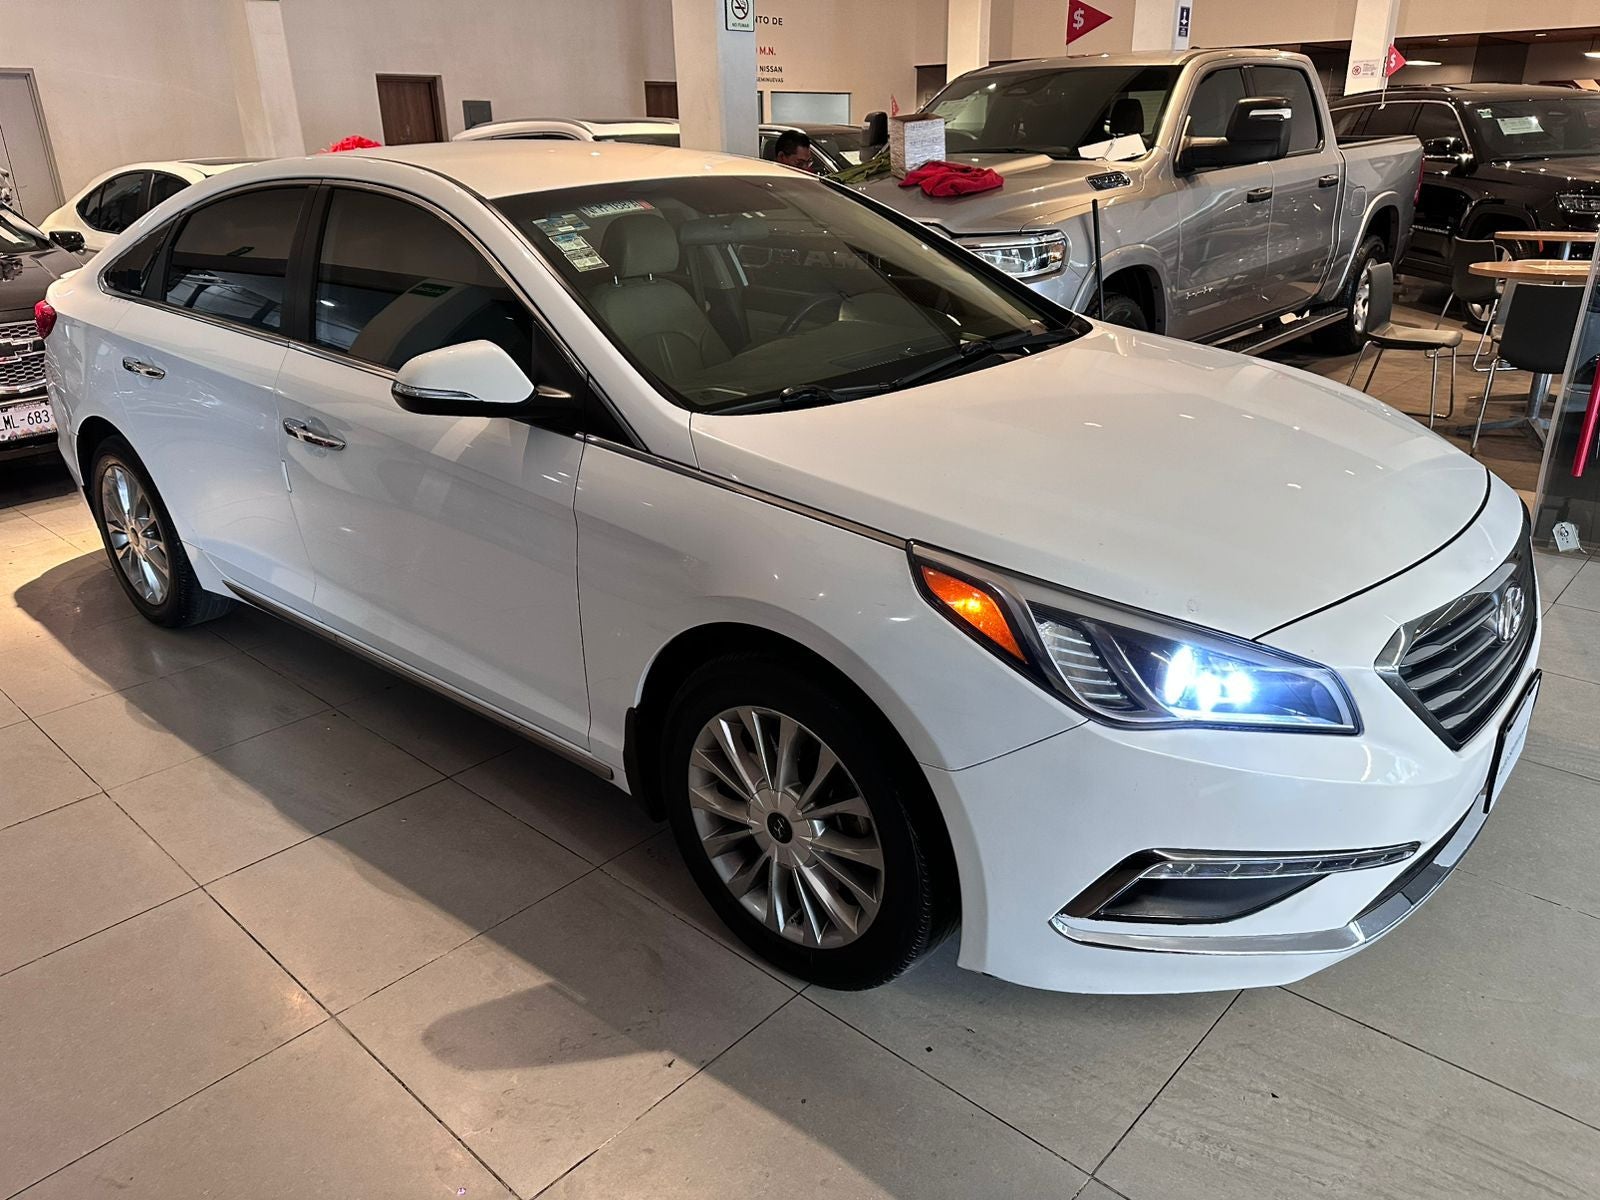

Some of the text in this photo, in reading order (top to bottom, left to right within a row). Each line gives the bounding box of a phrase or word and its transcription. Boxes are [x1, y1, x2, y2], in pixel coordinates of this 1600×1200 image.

[772, 17, 783, 26] DE
[1072, 8, 1085, 30] $
[759, 46, 776, 56] M.N.
[759, 65, 783, 73] NISSAN
